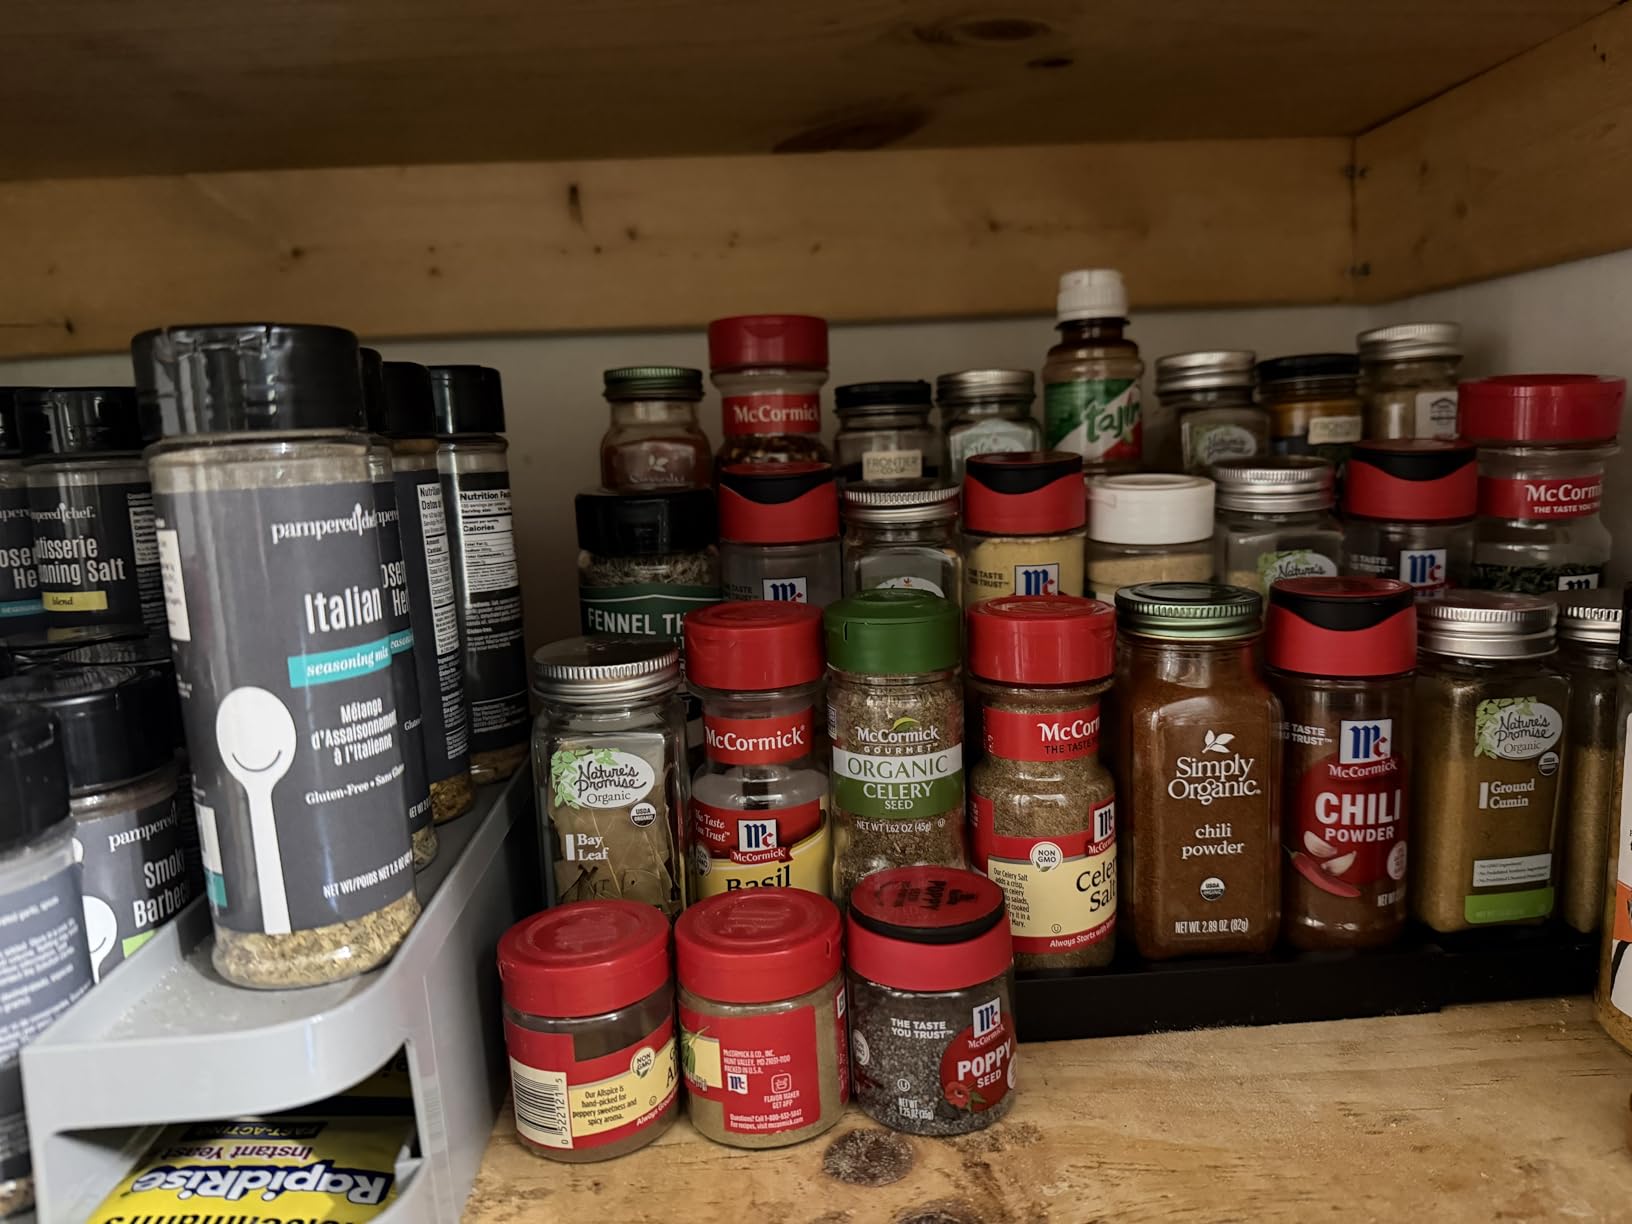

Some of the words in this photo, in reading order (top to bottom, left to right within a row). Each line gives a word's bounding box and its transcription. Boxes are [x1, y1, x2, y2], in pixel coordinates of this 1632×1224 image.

[460, 492, 498, 501] Nutrition
[1526, 484, 1601, 502] McCorm
[1553, 505, 1577, 513] TASTE
[271, 512, 356, 545] pampered
[463, 525, 495, 533] Calories
[87, 558, 126, 582] Salt
[979, 571, 1004, 580] TASTE
[304, 585, 382, 634] Italian
[588, 607, 656, 635] FENNEL
[306, 652, 374, 677] seasoning
[340, 697, 383, 724] Mélange
[1292, 723, 1325, 736] TASTE
[1500, 712, 1550, 731] Nature's
[705, 726, 804, 751] McCormick
[855, 725, 940, 743] McCormick
[1494, 728, 1555, 748] Promise
[864, 744, 932, 754] GOURMET
[1045, 745, 1064, 755] THE
[1504, 741, 1541, 754] Organic
[578, 761, 639, 781] Nature's
[847, 755, 948, 779] ORGANIC
[1176, 753, 1255, 782] Simply
[1328, 760, 1398, 779] McCormick
[305, 782, 369, 805] Gluten-Free
[574, 779, 647, 798] Promise
[863, 781, 934, 800] CELERY
[1167, 778, 1258, 806] Organic
[1490, 779, 1535, 794] Ground
[587, 791, 631, 805] Organic
[885, 800, 913, 810] SEED
[1489, 795, 1529, 809] Cumin
[1315, 789, 1402, 826] CHILI
[704, 814, 725, 829] Taste
[856, 819, 869, 830] NET
[871, 821, 883, 832] WT
[886, 822, 900, 833] 1.62
[901, 823, 913, 833] OZ
[1195, 823, 1232, 839] chili
[1325, 826, 1394, 842] POWDER
[577, 834, 604, 848] Bay
[578, 848, 609, 861] Leaf
[732, 848, 786, 863] McCormick
[1181, 840, 1245, 859] powder
[726, 864, 792, 892] Basil
[1001, 870, 1017, 881] Celery
[1017, 871, 1028, 881] Salt
[1011, 904, 1030, 913] cooked
[1175, 921, 1188, 934] NET
[1202, 920, 1218, 933] 2.89
[1230, 918, 1249, 933] (82g)
[1049, 937, 1076, 948] Always
[1076, 932, 1096, 944] Starts
[890, 1018, 910, 1029] THE
[913, 1021, 946, 1030] TASTE
[892, 1027, 911, 1038] YOU
[968, 1025, 1005, 1049] McCormick
[637, 1053, 651, 1064] NON
[637, 1060, 652, 1070] GMO
[723, 1058, 736, 1066] HUNT
[957, 1038, 1012, 1081] POPPY
[724, 1066, 742, 1074] PACKED
[976, 1069, 1001, 1088] SEED
[585, 1091, 595, 1099] Our
[597, 1087, 618, 1099] Allspice
[764, 1094, 782, 1103] FLAVOR
[783, 1090, 800, 1100] MAKER
[572, 1109, 597, 1119] peppery
[597, 1104, 626, 1115] sweetness
[627, 1099, 637, 1107] and
[581, 1096, 618, 1108] hand-picked
[772, 1101, 782, 1109] GET
[783, 1099, 793, 1108] APP
[588, 1117, 603, 1126] spicy
[604, 1114, 624, 1123] aroma.
[636, 1110, 658, 1127] Always
[730, 1113, 754, 1122] Questions?
[755, 1113, 764, 1122] Call
[757, 1121, 768, 1129] visit
[161, 1143, 225, 1160] Yeast
[231, 1144, 313, 1160] Instant
[131, 1162, 387, 1205] RapidRise
